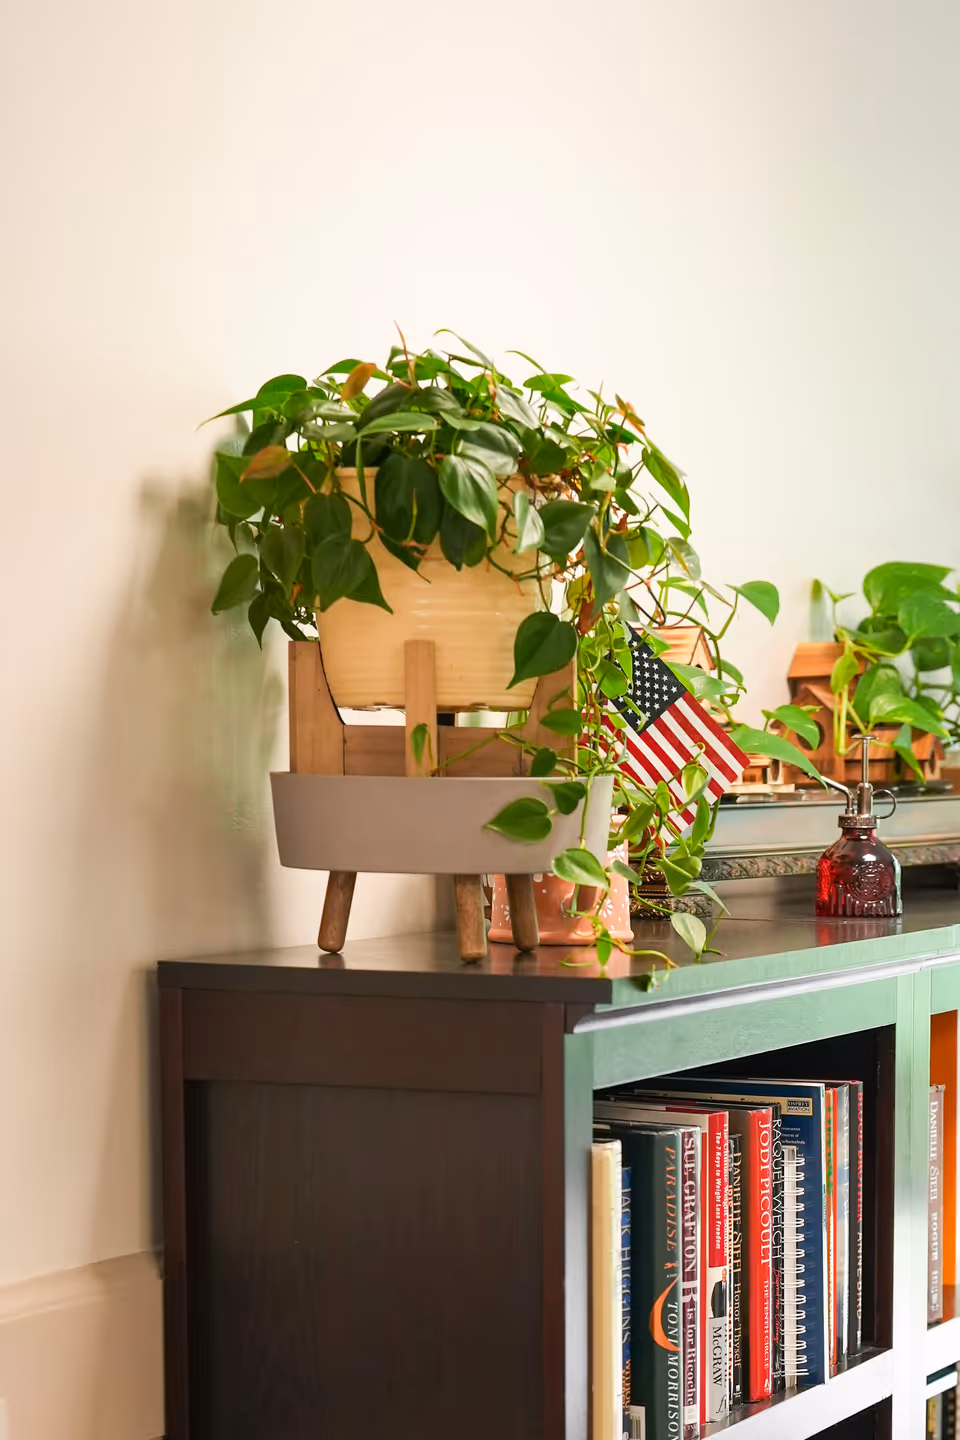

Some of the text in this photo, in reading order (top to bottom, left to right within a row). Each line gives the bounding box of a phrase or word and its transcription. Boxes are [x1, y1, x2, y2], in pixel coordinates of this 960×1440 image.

[714, 1152, 722, 1167] Keys
[929, 1101, 939, 1161] DANIELLE
[665, 1146, 677, 1252] PARADISE
[684, 1137, 697, 1272] SUE GRAFTON
[714, 1177, 722, 1202] Weight
[732, 1152, 743, 1273] DANIELLE STEEL
[758, 1120, 772, 1265] JODI PICOULT
[772, 1118, 784, 1259] RAQUEL WELCH
[929, 1166, 940, 1201] STEEL
[620, 1188, 632, 1344] JACK HIGGINS
[931, 1212, 939, 1261] ROGUE
[667, 1301, 680, 1346] TONI
[682, 1279, 698, 1406] R is for Ricoche
[712, 1326, 723, 1387] McGRAW
[733, 1282, 742, 1368] Honor Thyself
